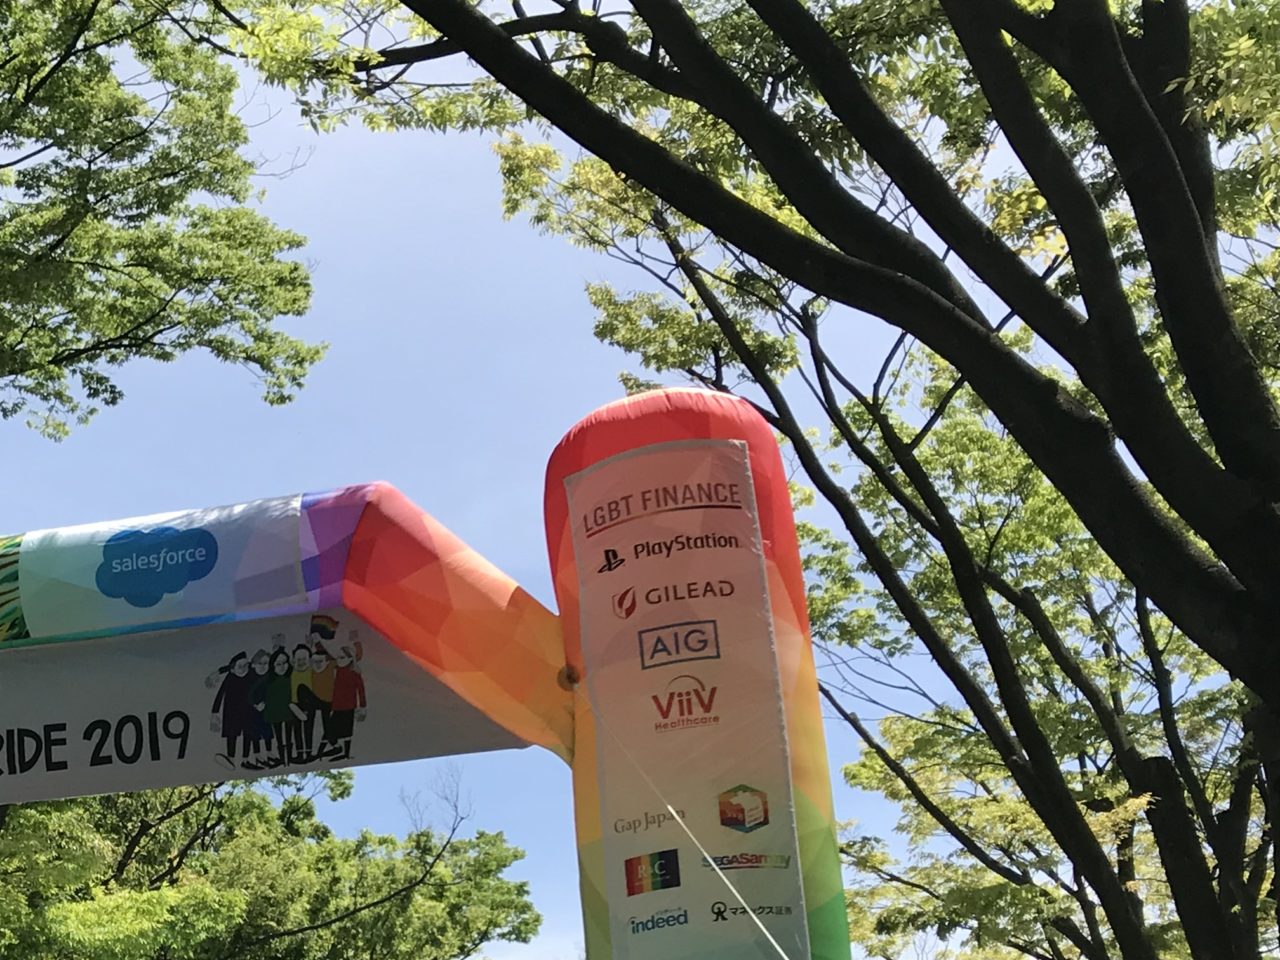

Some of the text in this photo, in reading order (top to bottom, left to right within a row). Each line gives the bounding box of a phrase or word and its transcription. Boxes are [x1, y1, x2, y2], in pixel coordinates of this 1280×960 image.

[583, 482, 741, 532] LGBT FINANCE
[110, 543, 207, 573] salesforce
[634, 531, 739, 559] PlayStation
[644, 580, 735, 605] GILEAD
[650, 629, 709, 660] AIG
[651, 686, 718, 720] ViiV
[82, 710, 191, 768] 2019
[614, 809, 686, 834] Gap Japan
[631, 909, 689, 934] indeed
